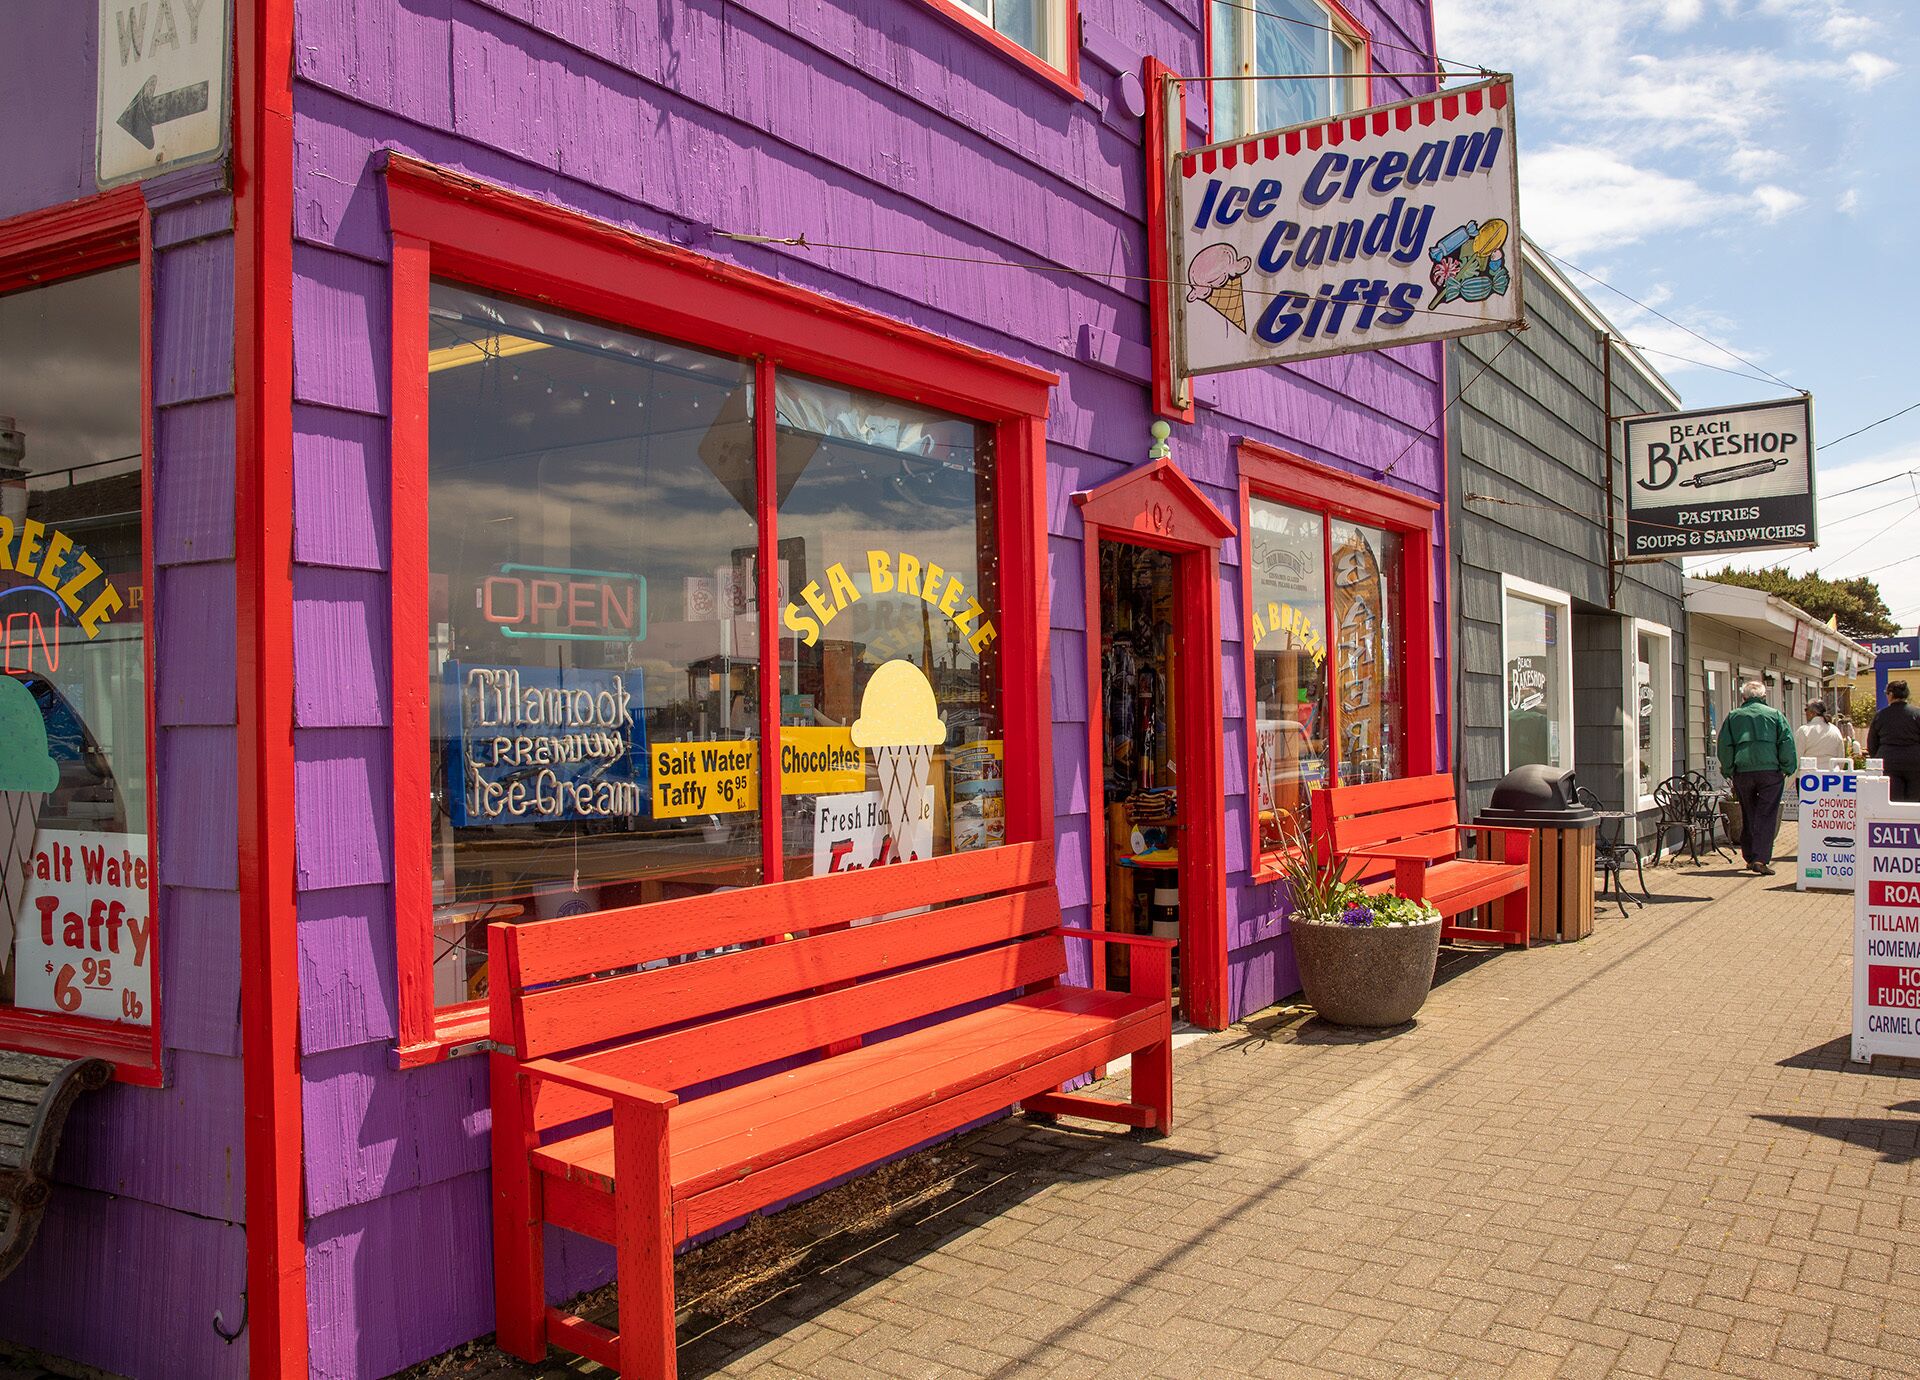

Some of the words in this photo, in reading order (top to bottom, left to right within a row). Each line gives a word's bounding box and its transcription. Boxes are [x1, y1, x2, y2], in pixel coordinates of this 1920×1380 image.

[116, 0, 204, 67] WAY
[1193, 179, 1282, 231] Ice
[1301, 127, 1503, 207] Cream
[1256, 197, 1436, 275] Candy
[1254, 278, 1423, 346] Gifts
[1669, 421, 1730, 444] BEACH
[1637, 432, 1798, 491] BAKESHOP
[1144, 499, 1175, 536] 102
[1678, 506, 1760, 525] PASTRIES
[1636, 534, 1686, 549] SOUPS
[1690, 532, 1701, 545] &
[1704, 524, 1806, 544] SANDWICHES
[483, 576, 634, 629] OPEN
[783, 562, 862, 648] SEA
[866, 550, 998, 655] BREEZE
[0, 606, 61, 675] EN
[1267, 602, 1327, 669] BREEZE
[469, 669, 635, 728] Tillamook
[492, 731, 626, 768] PREMIUM
[658, 751, 697, 776] Salt
[701, 750, 752, 773] Water
[781, 744, 860, 774] Chocolates
[659, 781, 707, 809] Taffy
[820, 804, 862, 834] Fresh
[1812, 809, 1829, 818] HOT
[1832, 810, 1845, 819] OR
[1873, 827, 1910, 845] SALT
[1811, 852, 1828, 862] BOX
[1825, 866, 1837, 876] TO
[1840, 867, 1853, 876] GO
[35, 895, 150, 967] Taffy
[1868, 1014, 1913, 1035] CARMEL
